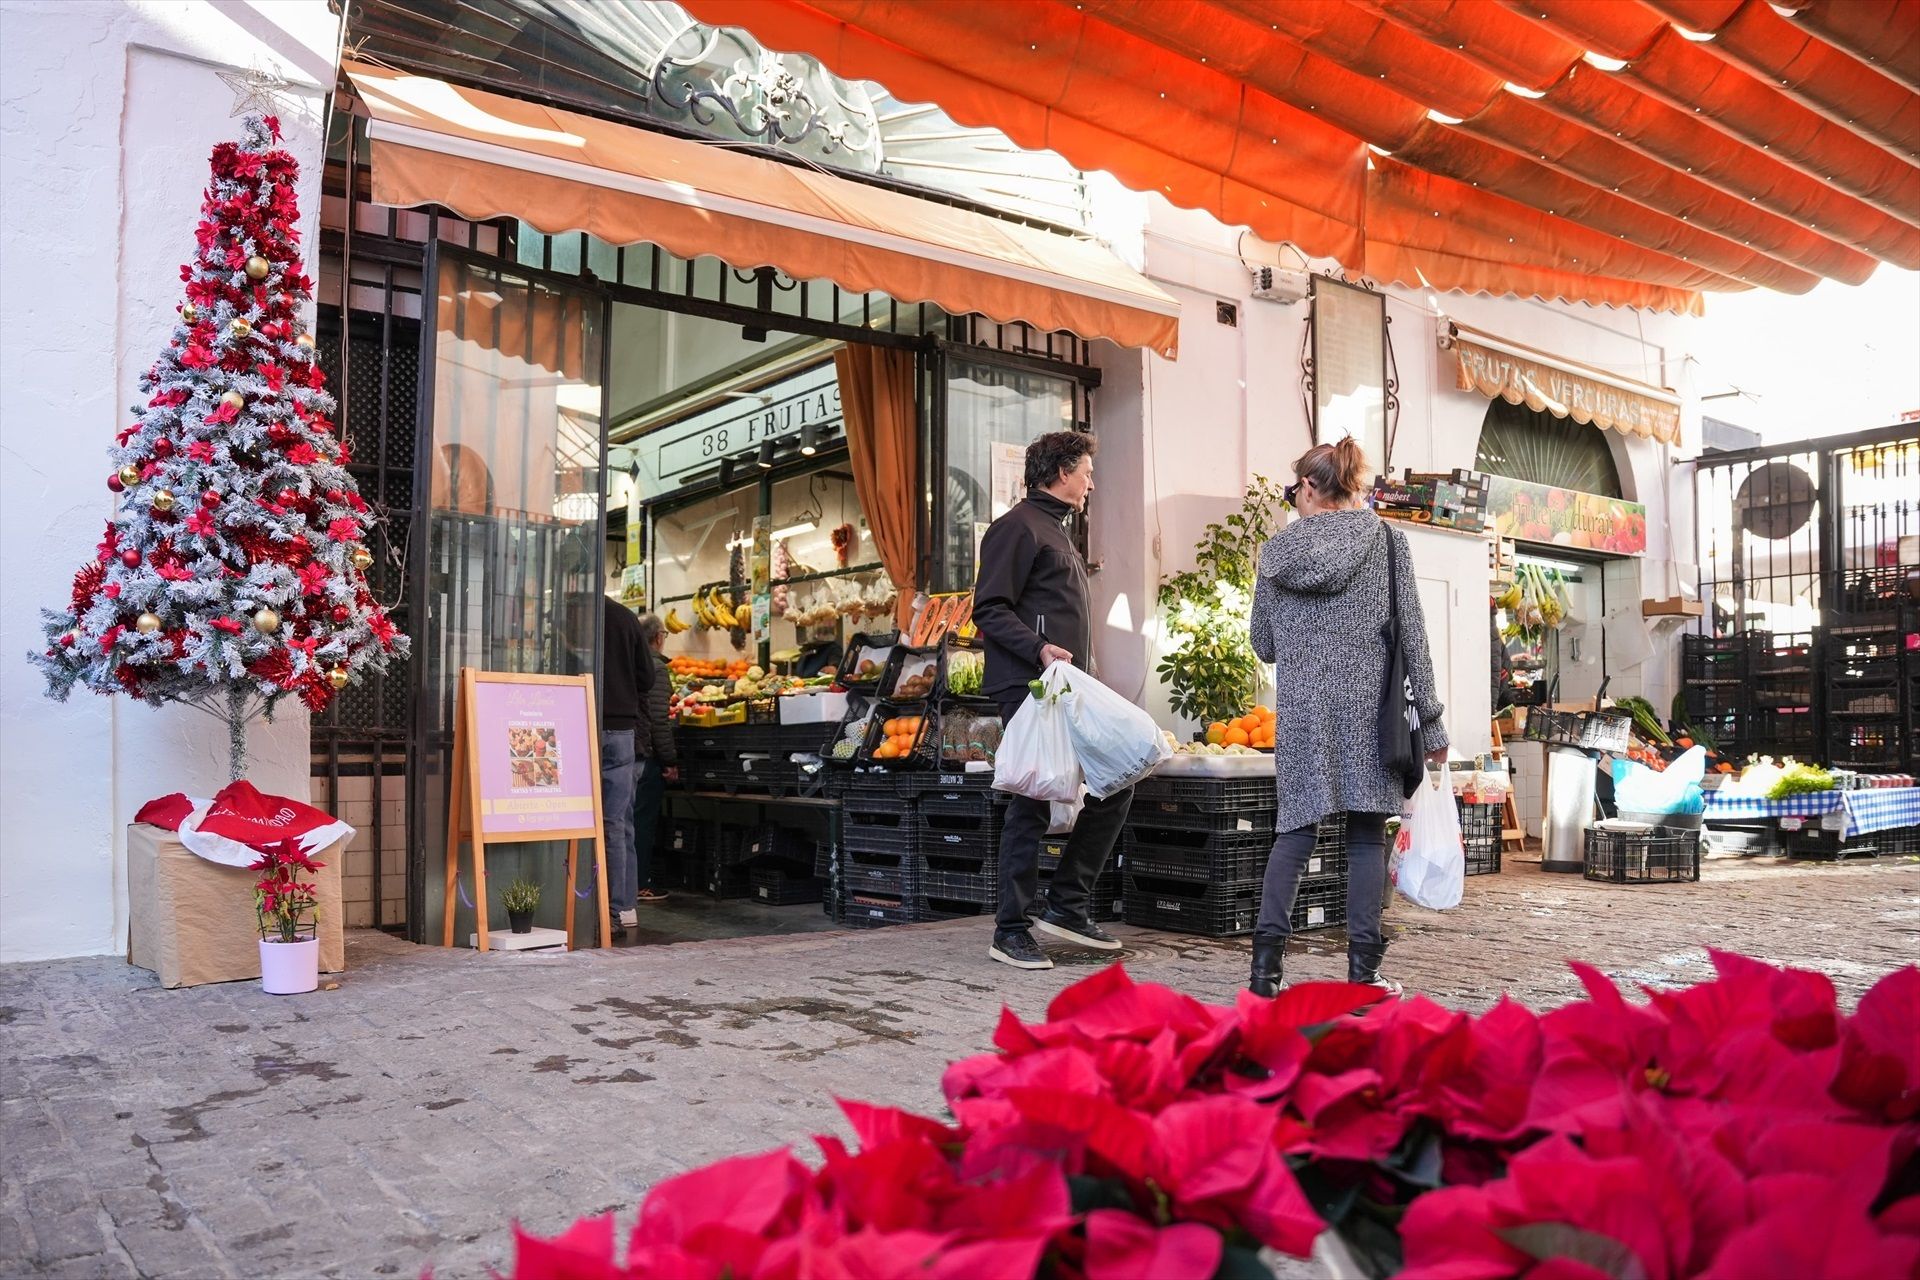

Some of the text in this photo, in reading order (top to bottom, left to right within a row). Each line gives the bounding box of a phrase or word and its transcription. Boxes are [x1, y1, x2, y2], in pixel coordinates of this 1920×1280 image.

[1460, 350, 1537, 392] FRUTAS
[702, 387, 842, 457] 38 FRUTAS
